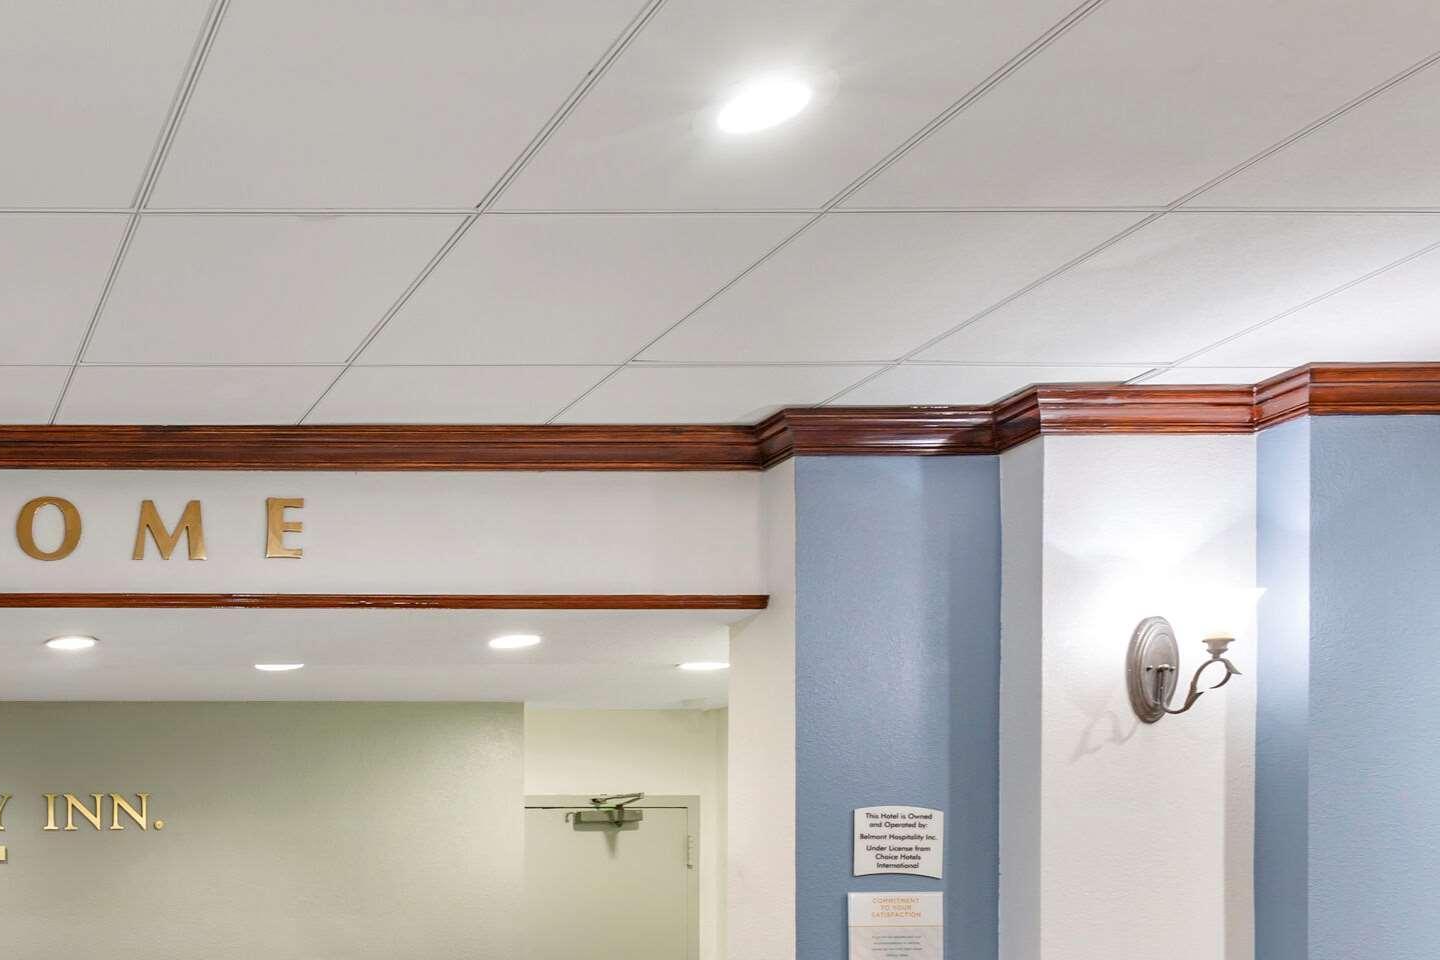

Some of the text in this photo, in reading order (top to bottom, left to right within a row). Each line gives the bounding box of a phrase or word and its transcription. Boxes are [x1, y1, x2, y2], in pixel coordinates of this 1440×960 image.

[43, 792, 165, 831] INN.
[865, 812, 879, 820] This
[880, 812, 899, 820] Hotel
[900, 812, 906, 820] is
[884, 821, 916, 829] Operated
[889, 833, 924, 842] Hospitality
